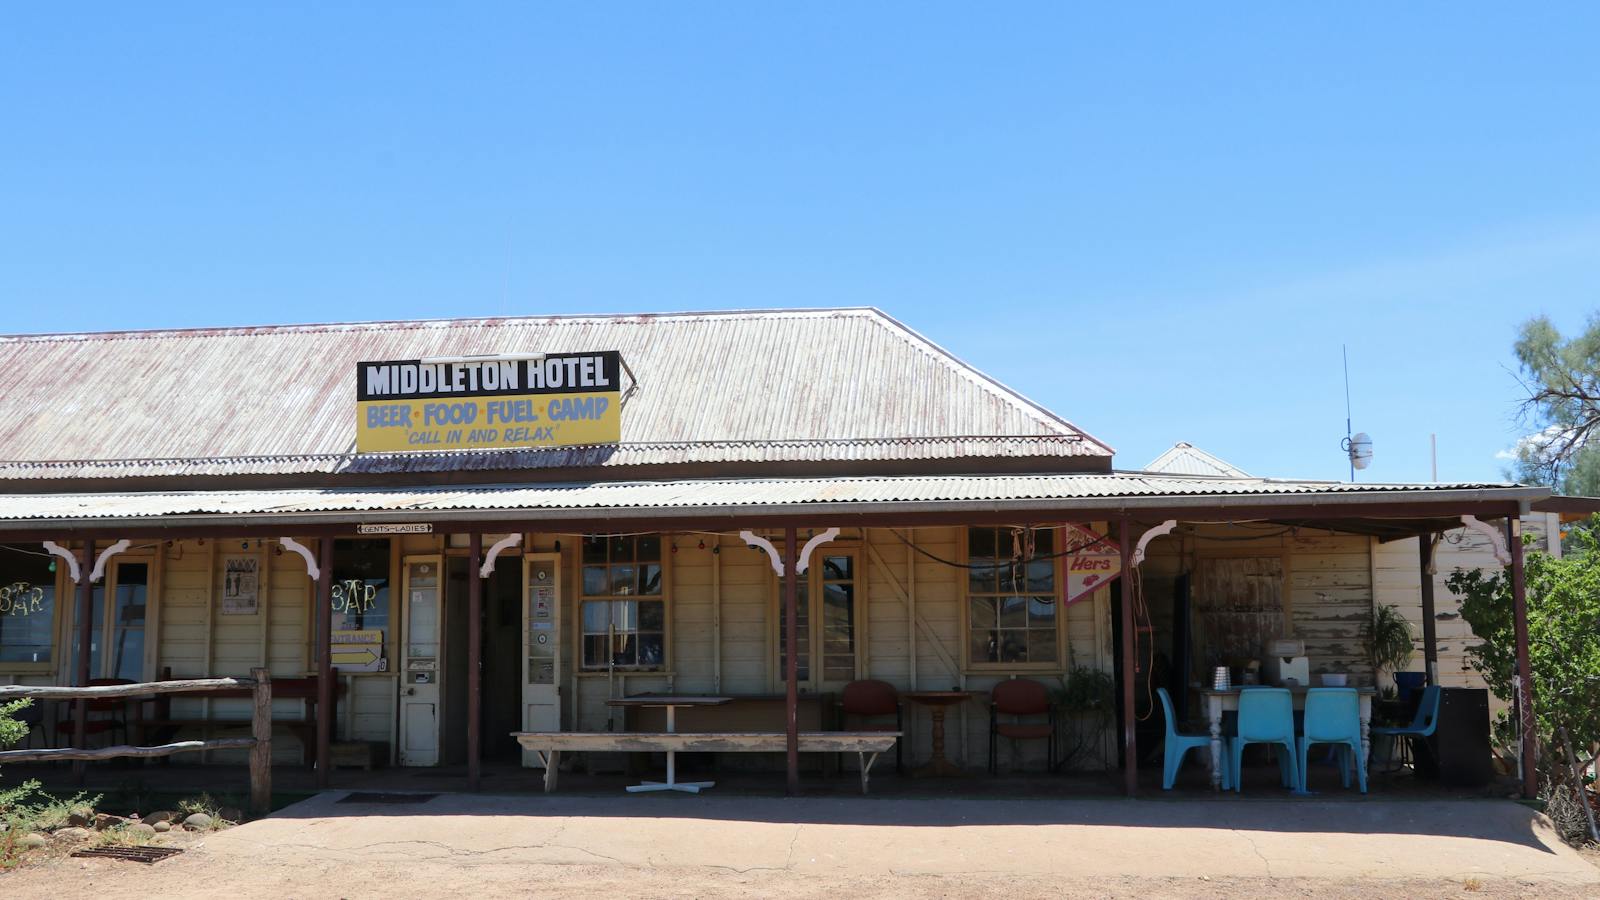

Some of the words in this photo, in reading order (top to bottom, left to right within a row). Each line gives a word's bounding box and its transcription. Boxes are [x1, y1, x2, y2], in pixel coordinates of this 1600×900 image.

[366, 361, 519, 395] MIDDLETON
[526, 356, 609, 389] HOTEL
[367, 404, 412, 428] BEER
[423, 402, 478, 426] FOOD
[487, 399, 537, 423] FUEL
[547, 397, 609, 421] CAMP
[446, 430, 463, 443] IN
[467, 428, 498, 443] AND
[1070, 557, 1111, 571] Hers
[0, 582, 44, 616] BAR
